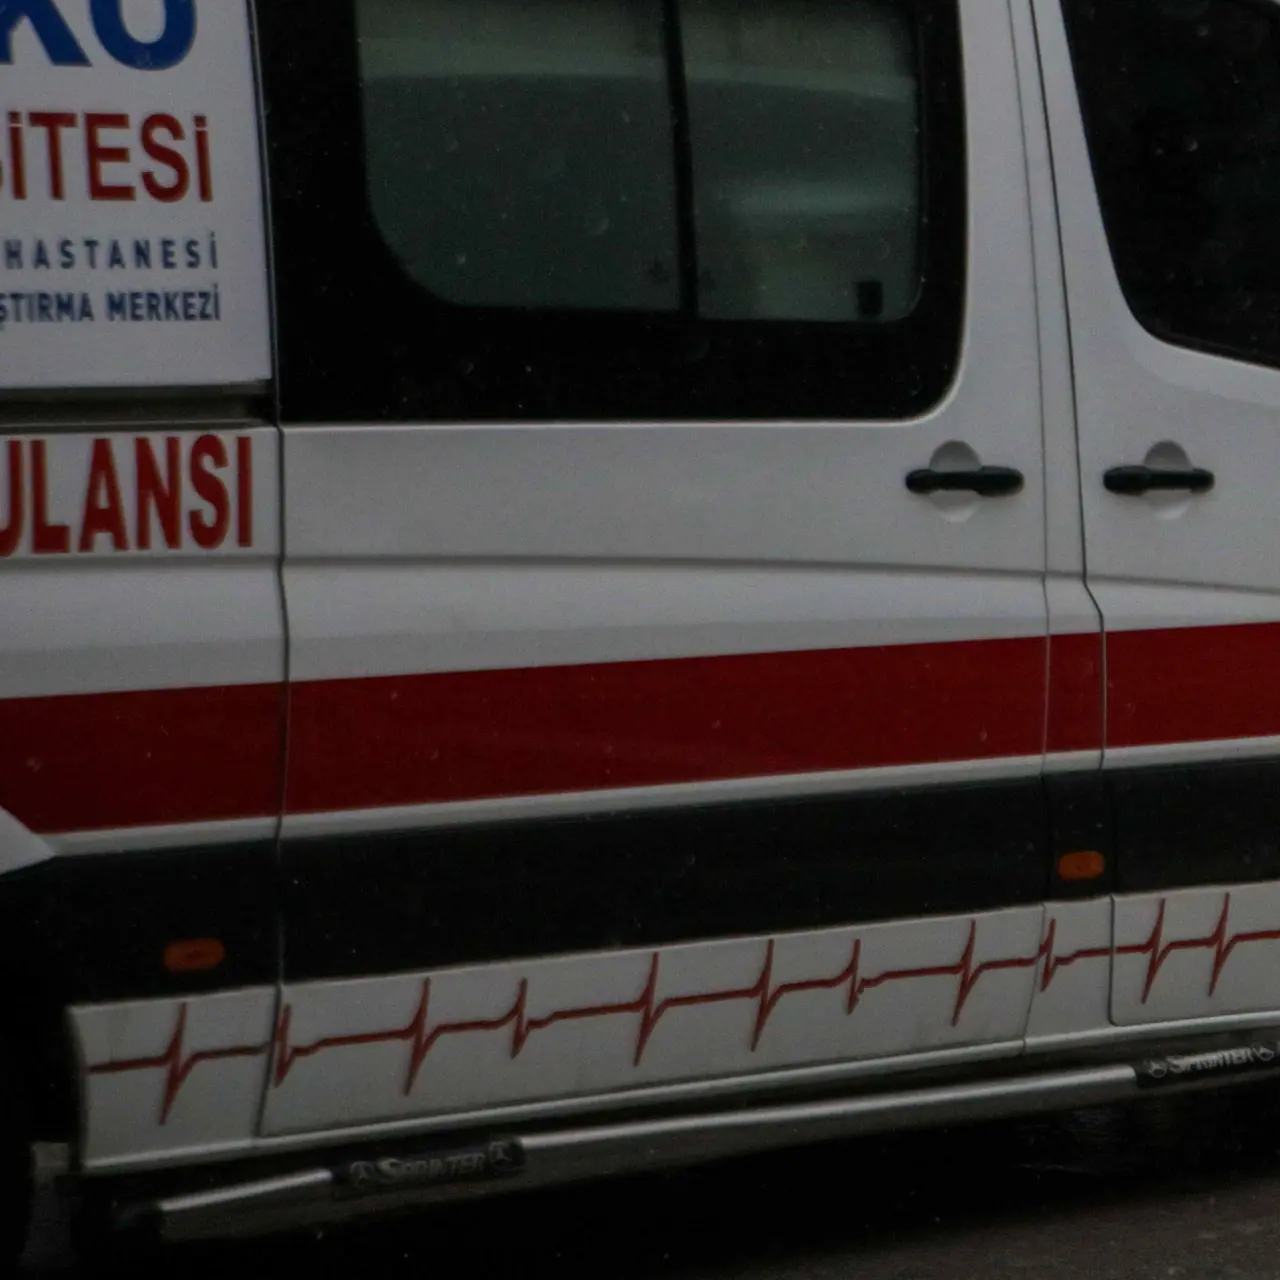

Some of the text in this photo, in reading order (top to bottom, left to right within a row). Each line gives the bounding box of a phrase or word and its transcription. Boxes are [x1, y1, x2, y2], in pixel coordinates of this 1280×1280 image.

[0, 111, 213, 203] İTESİ
[4, 232, 218, 270] HASTANESİ
[106, 283, 220, 322] MERKEZİ
